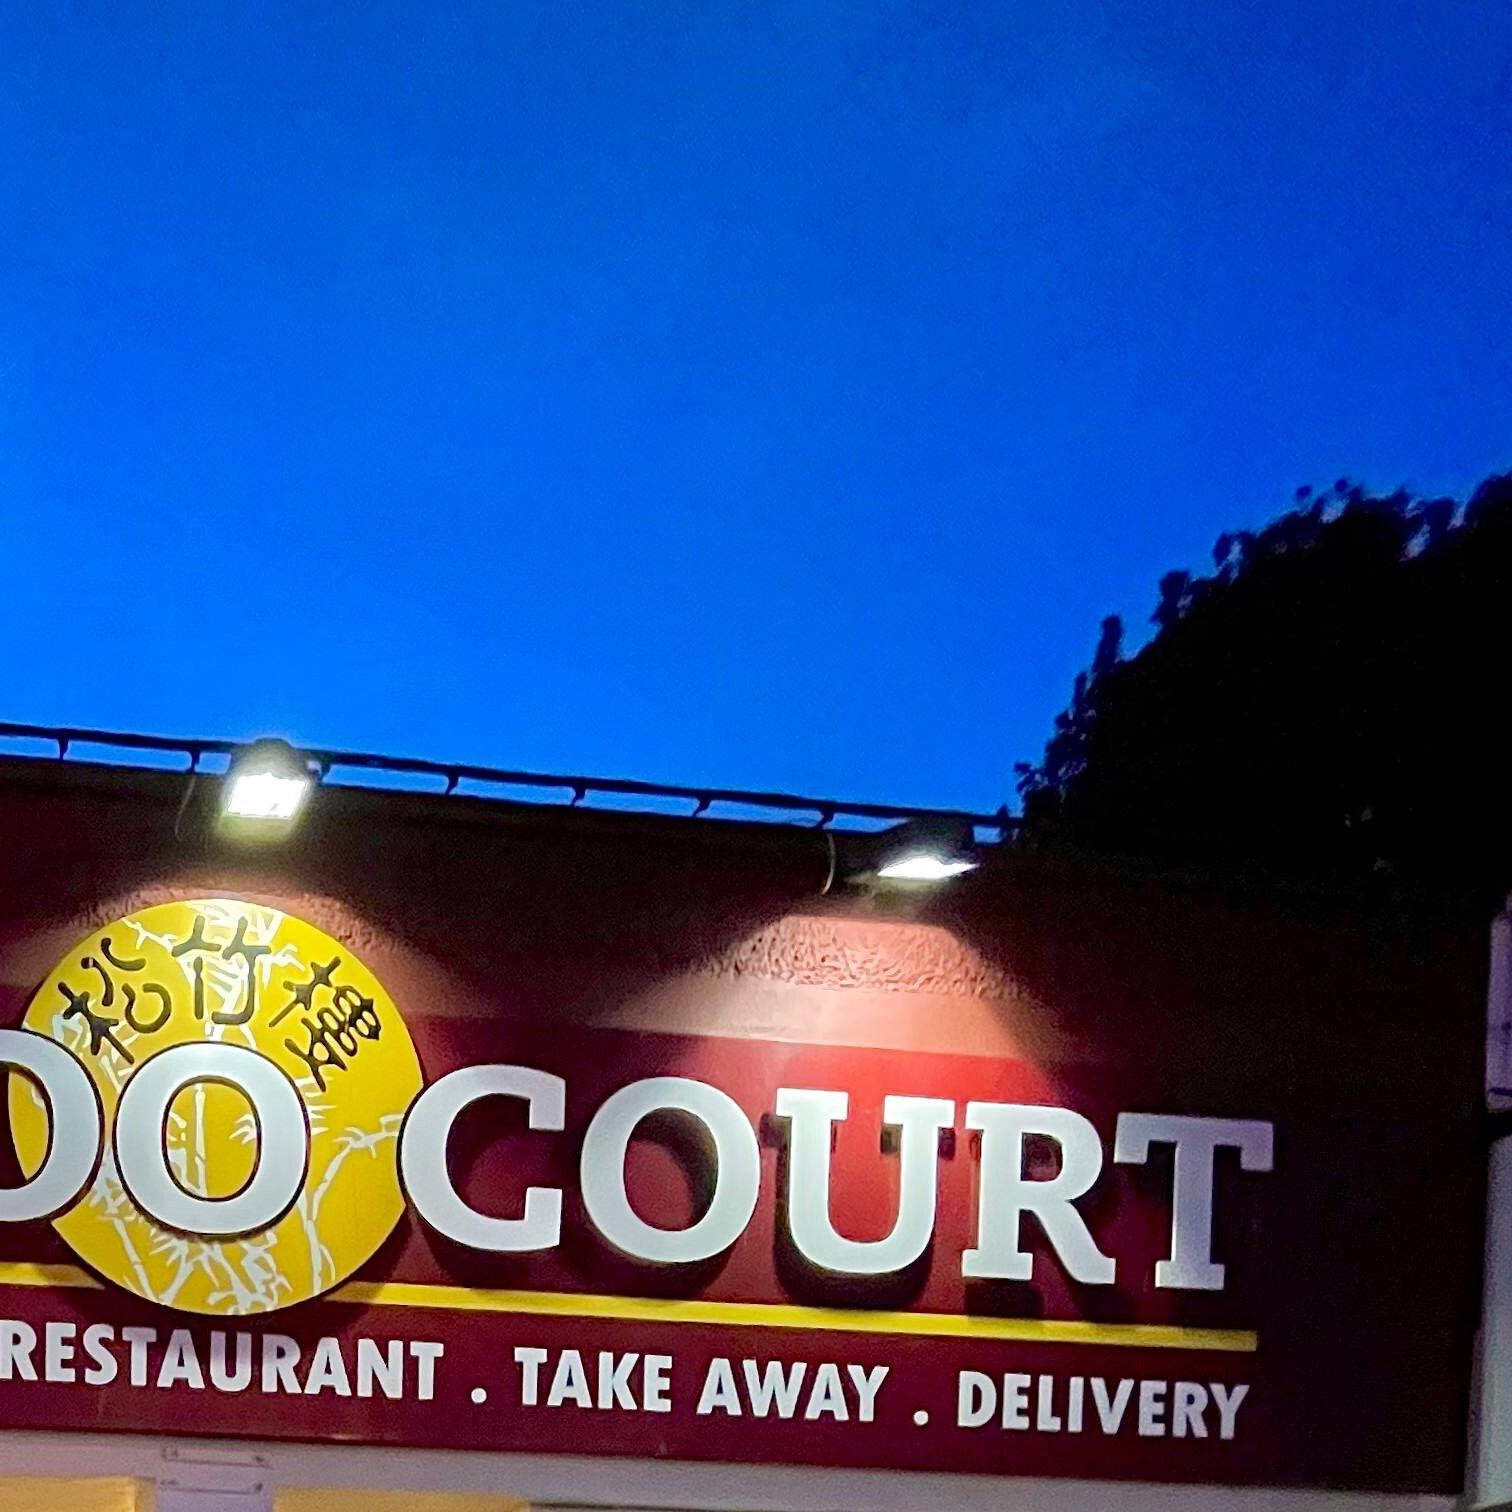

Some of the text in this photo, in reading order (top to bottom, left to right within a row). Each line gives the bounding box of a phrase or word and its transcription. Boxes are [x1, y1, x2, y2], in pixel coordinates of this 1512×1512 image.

[400, 1063, 1275, 1291] COURT
[514, 1346, 673, 1414] TAKE
[696, 1357, 891, 1423] AWAY
[956, 1370, 1251, 1440] DELIVERY
